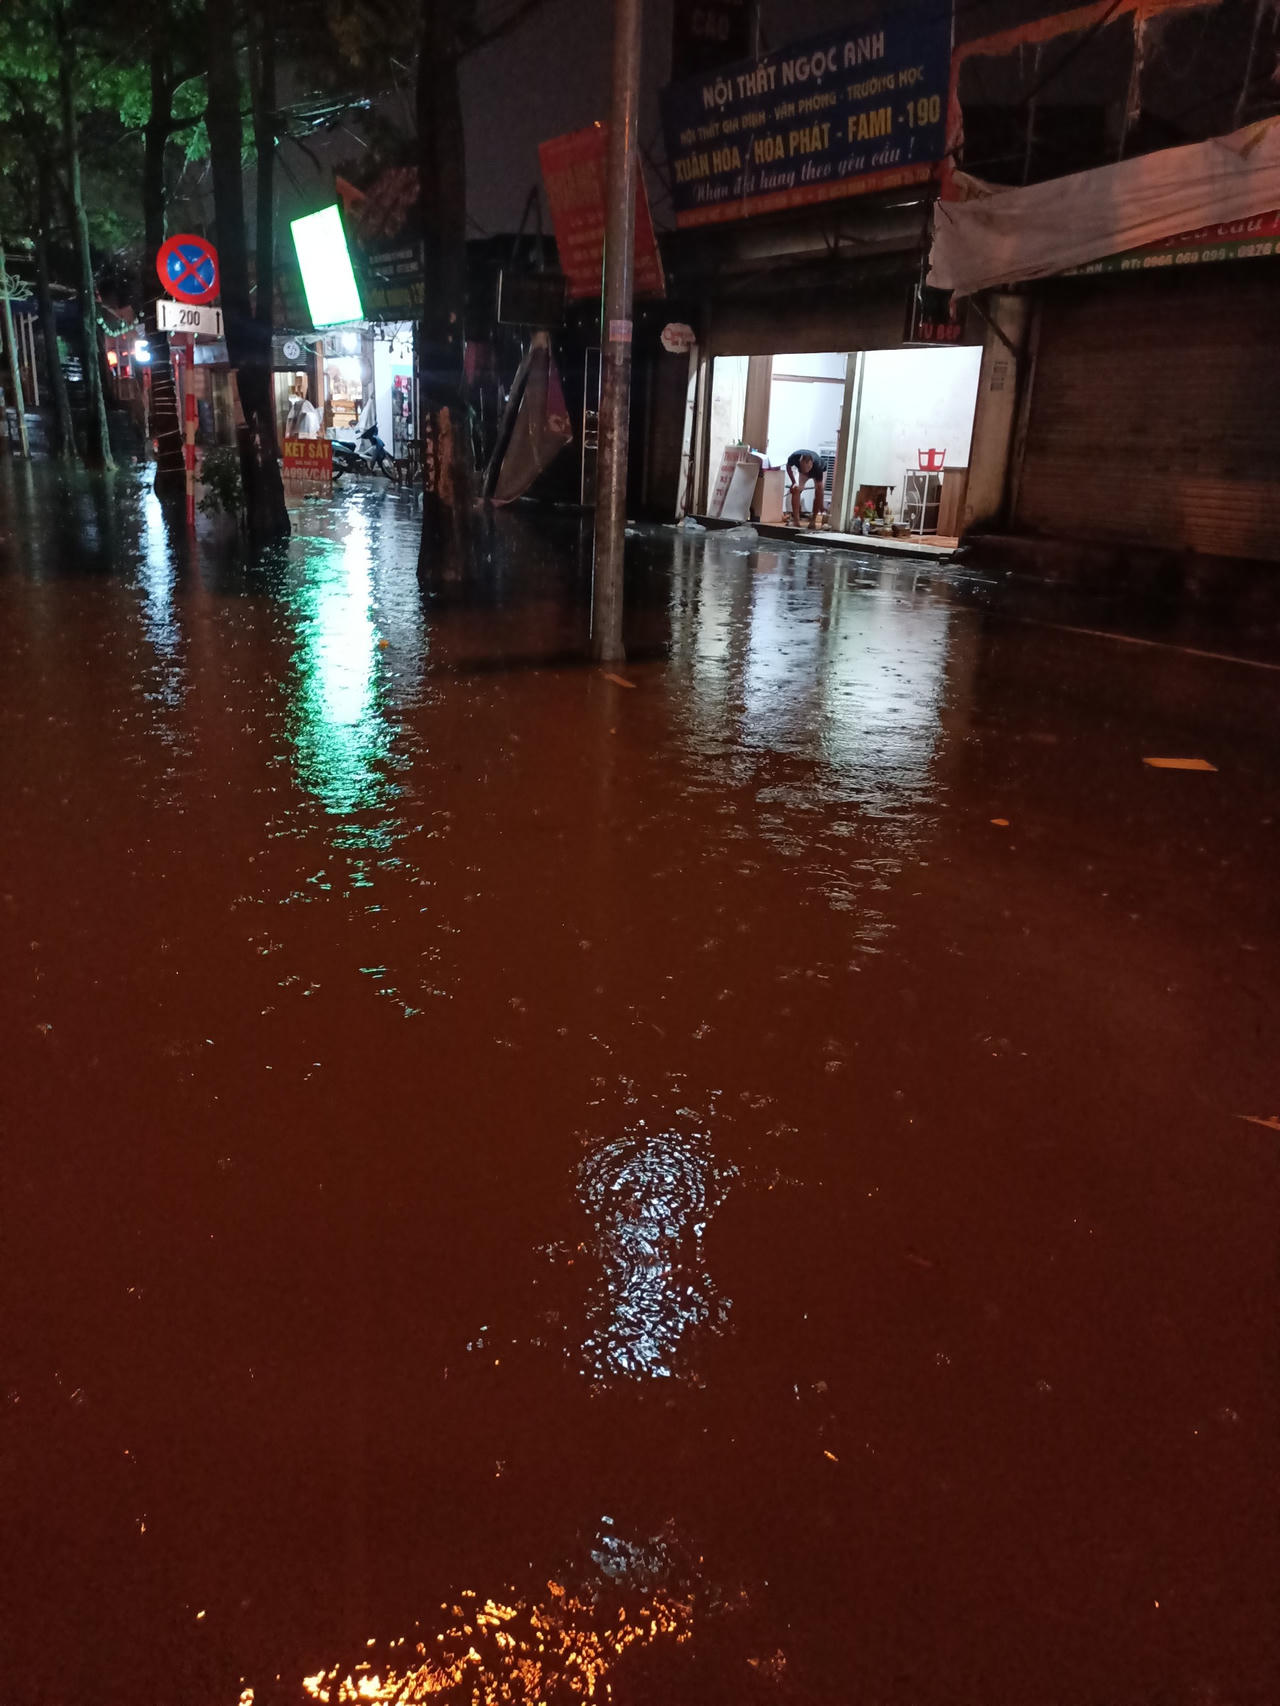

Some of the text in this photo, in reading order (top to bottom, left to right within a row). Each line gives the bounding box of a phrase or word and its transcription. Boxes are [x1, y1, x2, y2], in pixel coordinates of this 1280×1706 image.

[703, 31, 886, 112] NỘI THẤT NGỌC ANH
[674, 151, 711, 185] XUÂN
[788, 119, 832, 158] PHÁT
[847, 105, 893, 144] FAMI
[801, 159, 832, 182] theo
[179, 310, 201, 326] 200
